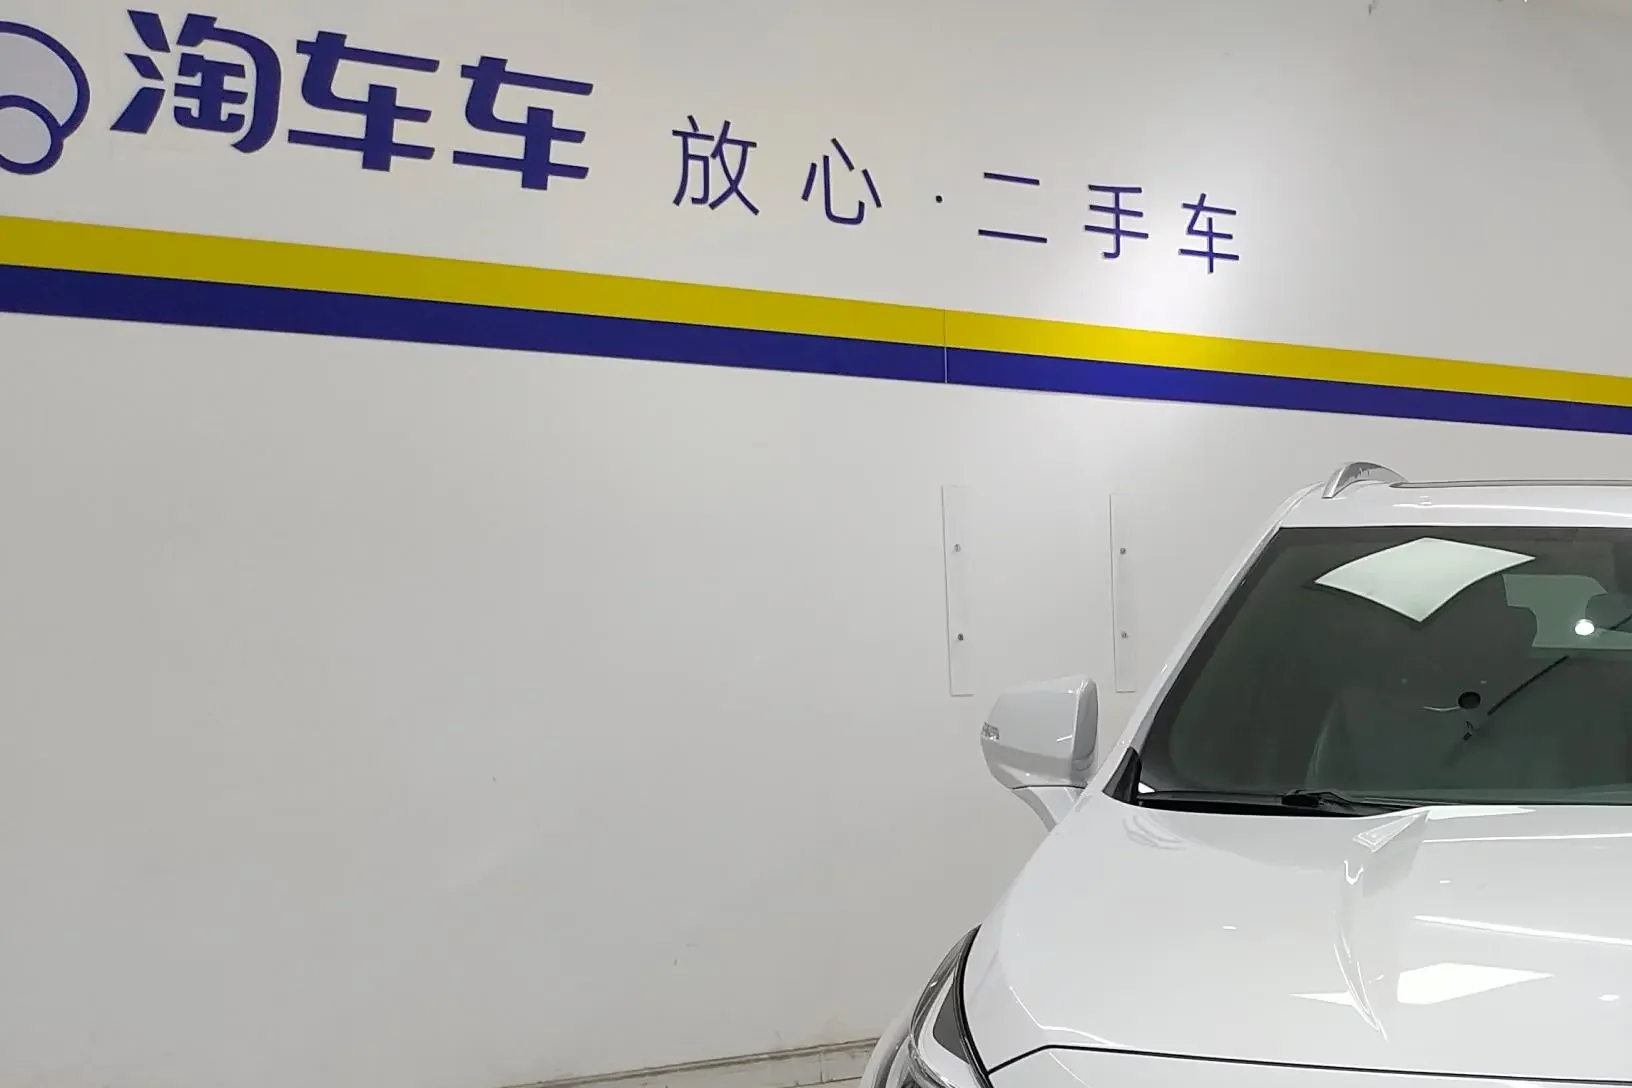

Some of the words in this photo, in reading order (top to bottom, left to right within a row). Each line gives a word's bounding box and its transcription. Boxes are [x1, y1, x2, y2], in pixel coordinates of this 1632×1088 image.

[110, 9, 594, 191] 淘车车
[671, 115, 1240, 273] 放心·二手车
